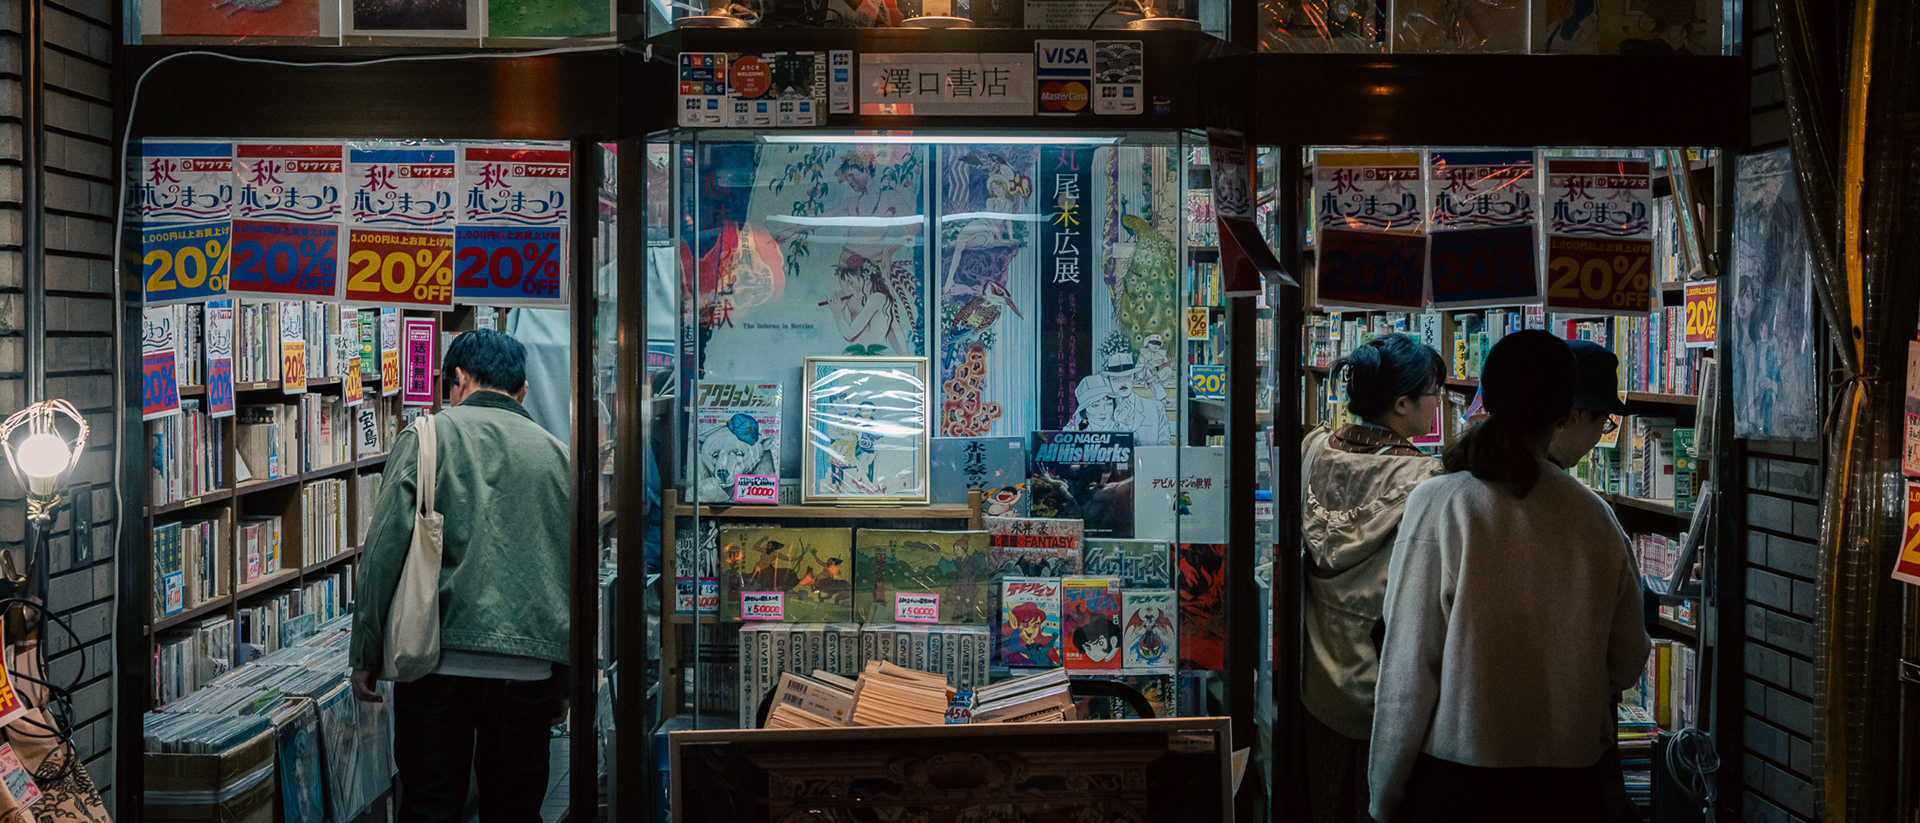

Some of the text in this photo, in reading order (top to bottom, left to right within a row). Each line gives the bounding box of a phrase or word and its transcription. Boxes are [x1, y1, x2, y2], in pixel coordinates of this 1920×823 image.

[833, 54, 848, 65] JCB
[1044, 47, 1088, 64] VISA
[814, 53, 826, 104] WELCOME
[880, 67, 1011, 99] 澤口書店
[686, 98, 701, 110] JCB
[735, 102, 748, 113] JCB
[780, 102, 793, 112] JCB
[1040, 91, 1088, 101] MasterCard
[149, 158, 180, 186] 秋
[251, 159, 284, 187] 秋
[361, 164, 398, 192] 秋
[475, 162, 512, 190] 秋
[1328, 168, 1364, 195] 秋
[1442, 168, 1477, 195] 秋
[169, 184, 180, 194] の
[272, 185, 284, 195] の
[385, 190, 397, 200] の
[499, 189, 510, 199] の
[1560, 174, 1596, 202] 秋
[1053, 146, 1080, 284] 丸尾末広展
[231, 239, 336, 284] 20%
[347, 248, 453, 294] 20%
[455, 242, 560, 289] 20%
[298, 275, 336, 292] OFF
[522, 279, 560, 294] OFF
[1549, 255, 1648, 300] 20%
[413, 284, 452, 301] OFF
[1612, 291, 1649, 307] OFF
[285, 352, 305, 384] 20%
[334, 336, 350, 376] 歌舞伎
[413, 342, 426, 391] 送料無料
[383, 359, 398, 388] 20%
[209, 369, 232, 406] 20%
[698, 384, 756, 407] アクション
[164, 394, 178, 407] OFF
[358, 411, 377, 448] 宝島
[1054, 434, 1111, 443] GO NAGAI
[1035, 443, 1131, 462] All His Works
[1152, 477, 1212, 489] デビルマンの世界
[1112, 614, 1119, 625] KC
